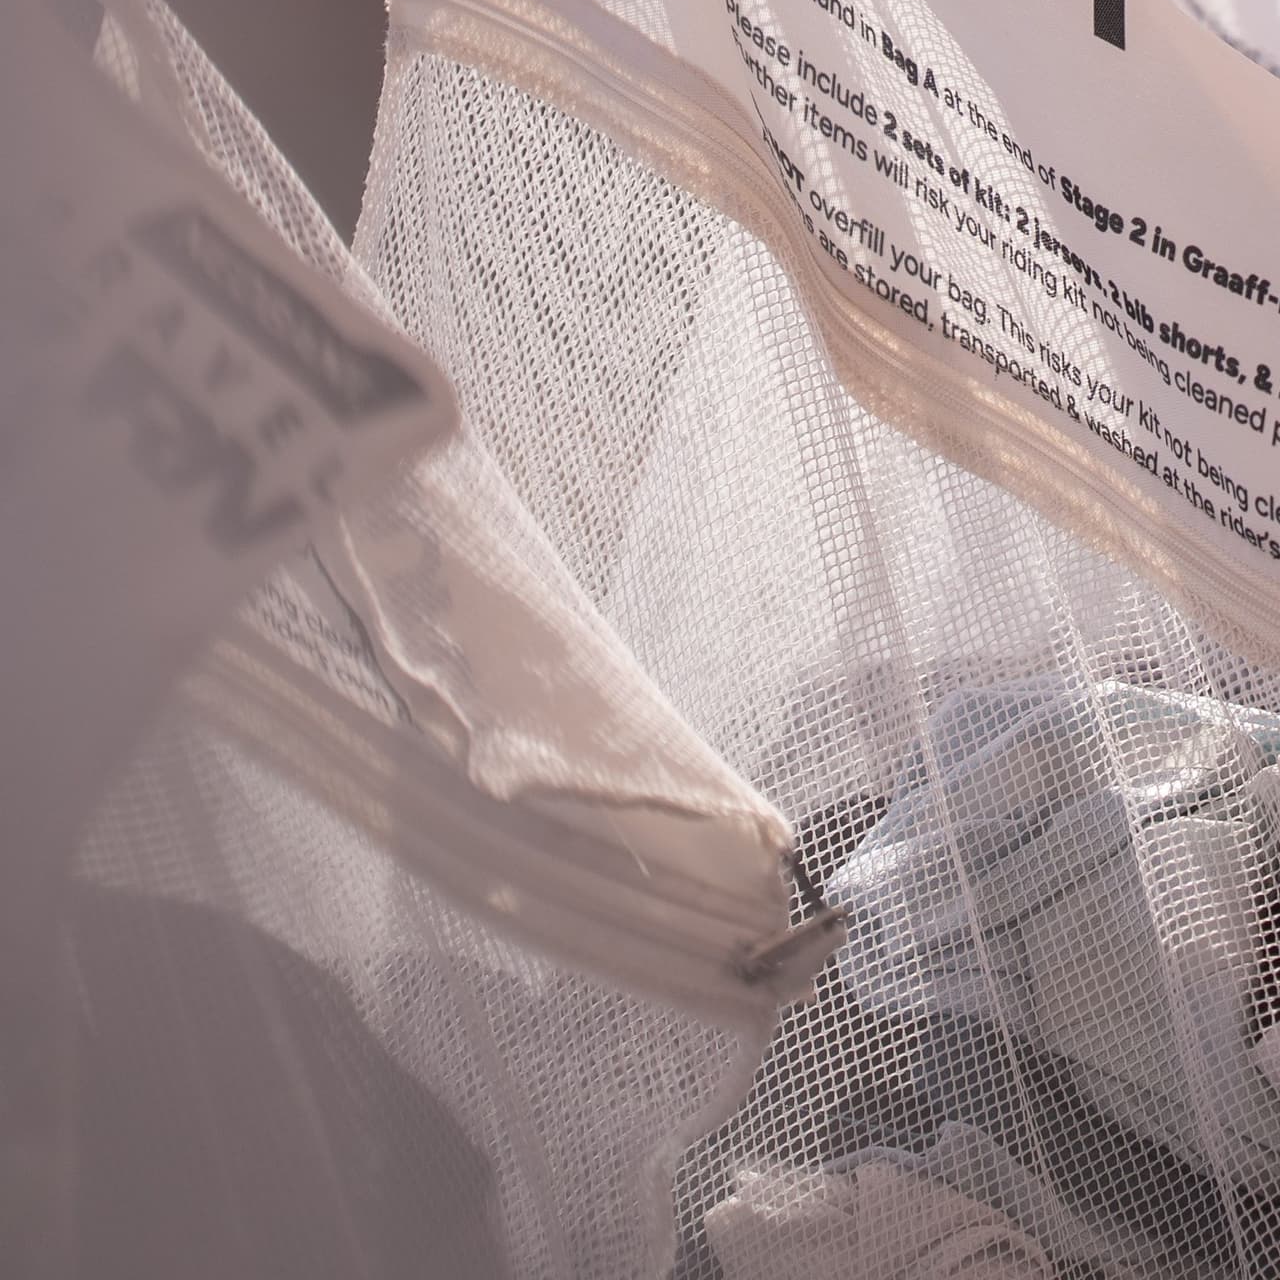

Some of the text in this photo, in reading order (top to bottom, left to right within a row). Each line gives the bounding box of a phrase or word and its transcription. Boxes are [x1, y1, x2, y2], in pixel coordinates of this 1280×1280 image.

[797, 50, 878, 125] include
[883, 110, 898, 141] 2
[902, 130, 945, 176] sets
[949, 166, 970, 195] of
[974, 176, 1011, 222] kit:
[1015, 206, 1030, 236] 2
[1108, 279, 1122, 309] 2
[1122, 290, 1155, 334] bib
[1159, 321, 1247, 385] shorts,
[1253, 363, 1273, 395] &
[803, 97, 868, 162] items
[874, 149, 910, 189] will
[915, 176, 950, 220] risk
[954, 204, 997, 250] your
[1001, 238, 1058, 298] riding
[1062, 275, 1088, 314] kit
[1092, 300, 1124, 339] not
[1123, 322, 1172, 386] being
[1174, 371, 1267, 434] cleaned
[860, 14, 877, 48] in
[881, 31, 919, 86] Bag
[923, 68, 939, 98] A
[944, 88, 964, 116] at
[967, 100, 998, 141] the
[1002, 133, 1035, 174] end
[1038, 163, 1056, 190] of
[1060, 176, 1124, 234] Stage
[1129, 217, 1148, 247] 2
[1151, 226, 1176, 262] in
[810, 190, 885, 257] overfill
[890, 244, 942, 291] your
[948, 273, 991, 326] bag.
[996, 303, 1036, 355] This
[1039, 341, 1082, 386] risks
[1086, 373, 1135, 417] your
[1138, 399, 1162, 440] kit
[1163, 427, 1193, 468] not
[1197, 448, 1249, 512] being
[819, 229, 848, 270] are
[940, 311, 1063, 411] transported
[1067, 395, 1082, 424] &
[1085, 410, 1159, 478] washed
[1162, 464, 1184, 496] at
[1183, 479, 1216, 520] the
